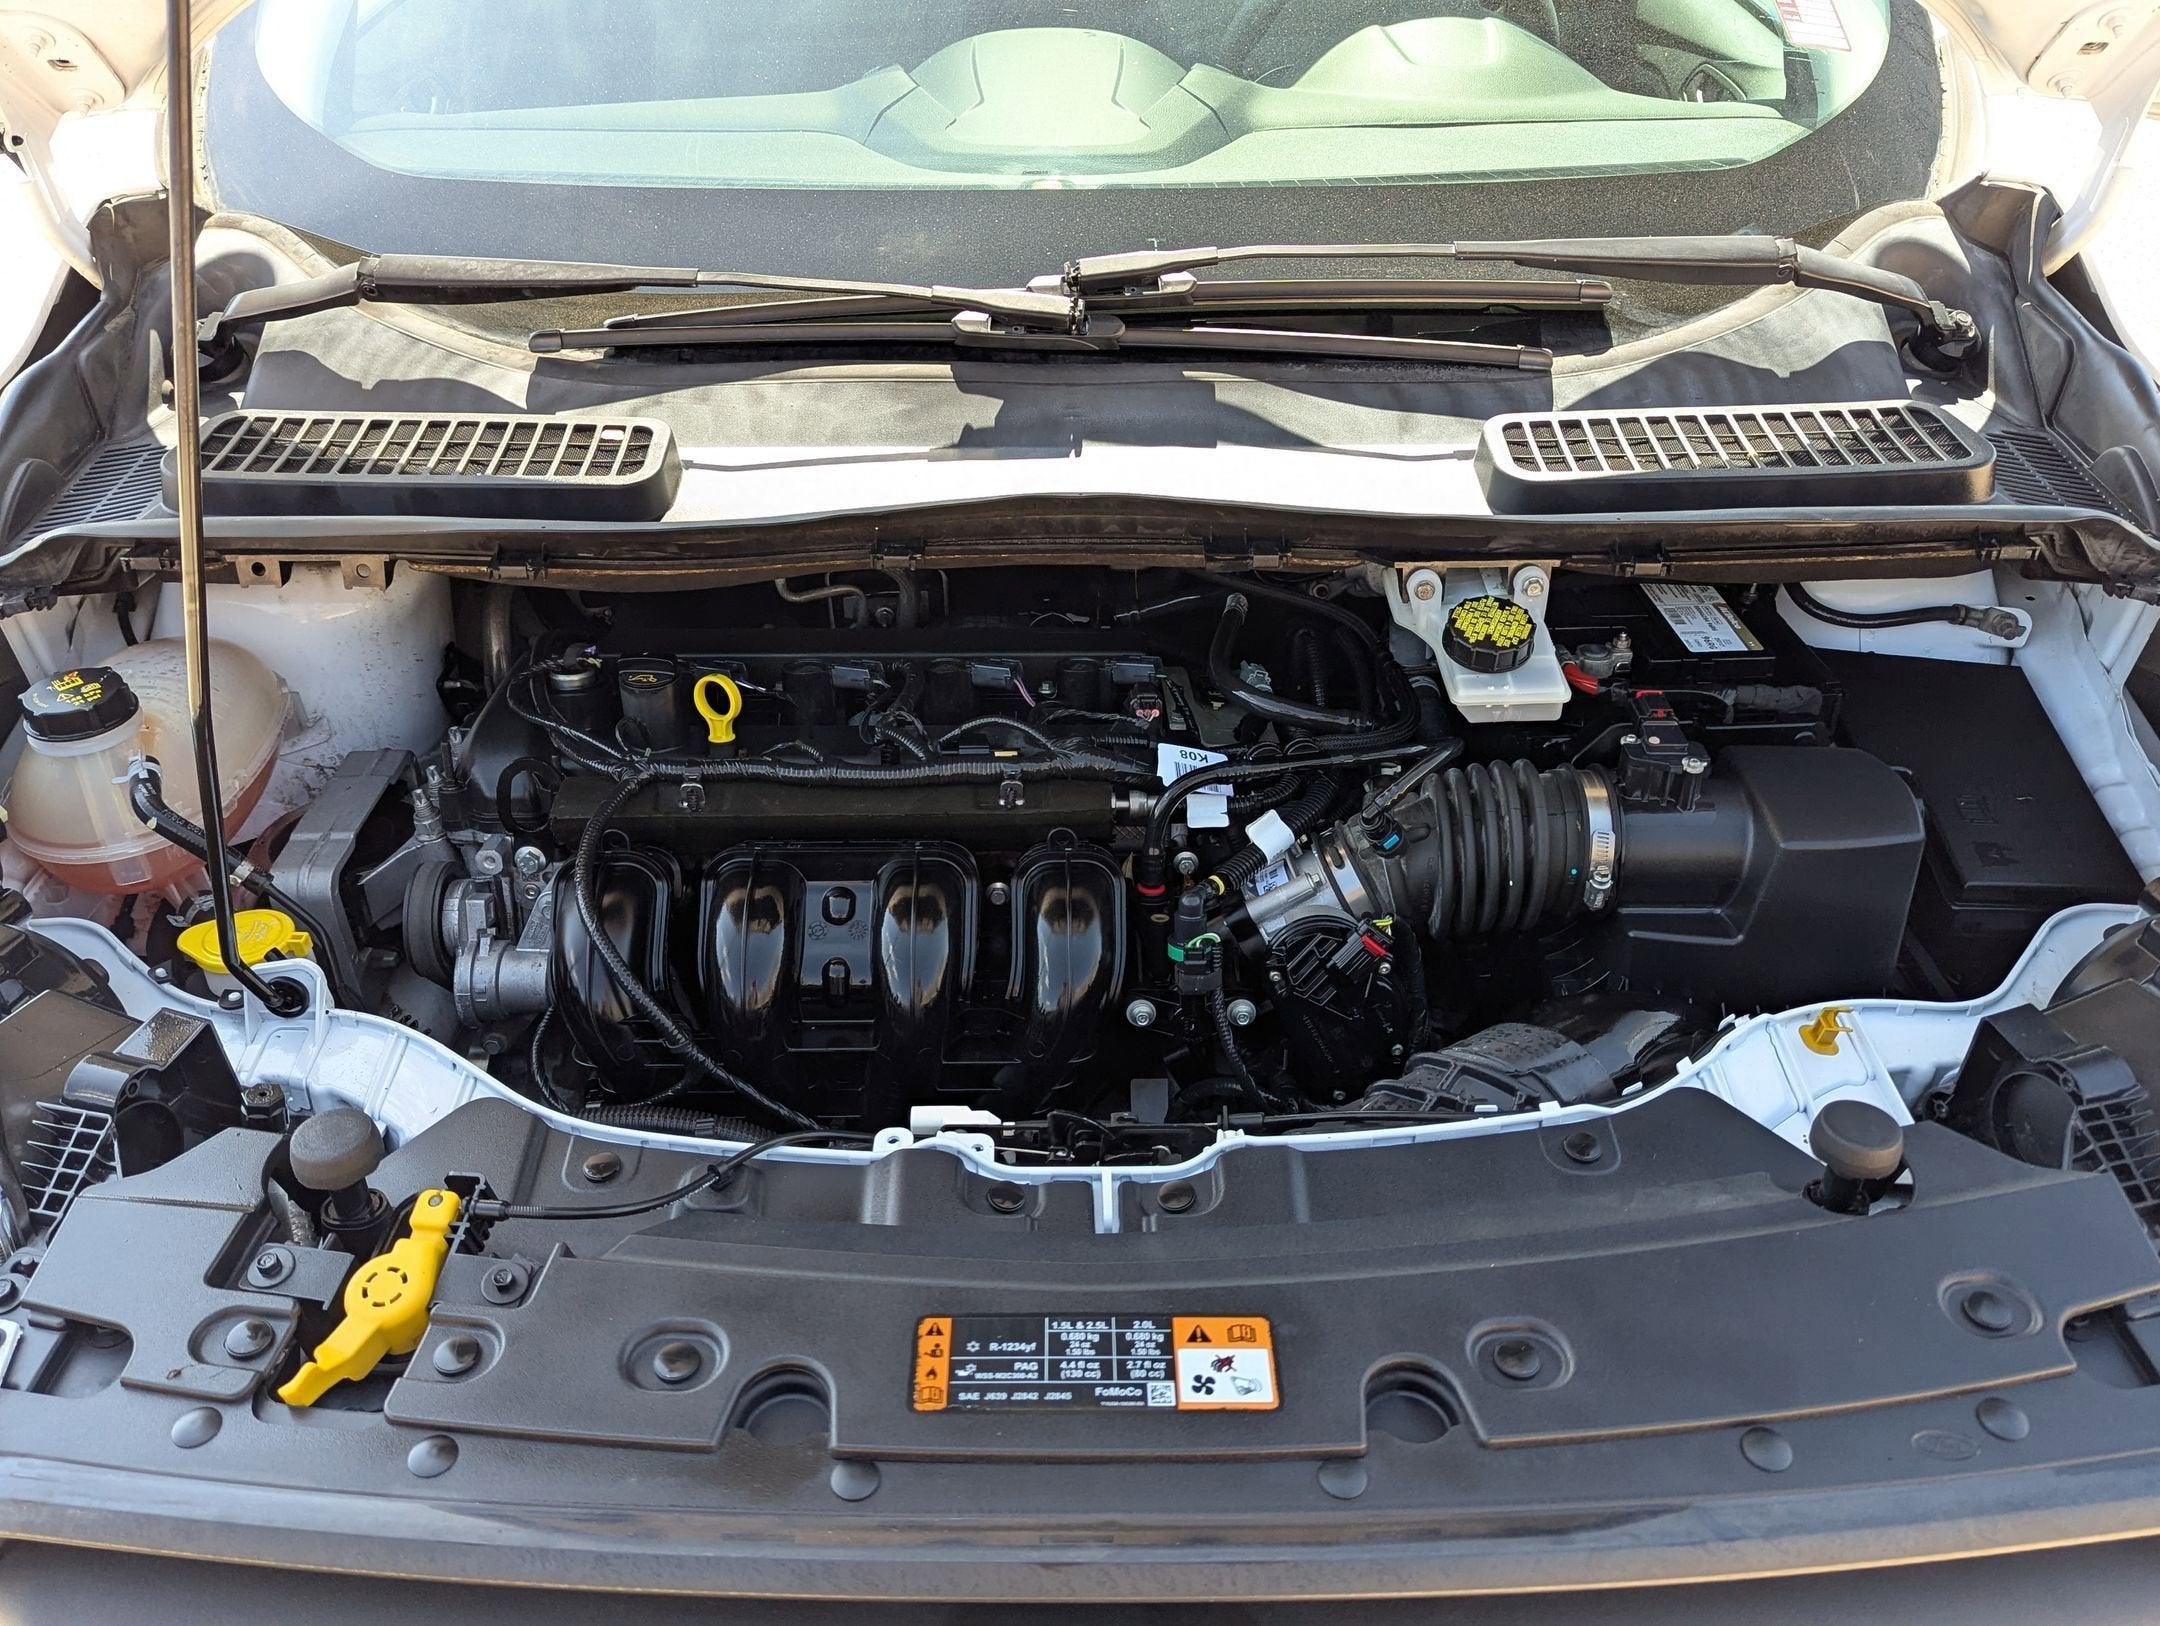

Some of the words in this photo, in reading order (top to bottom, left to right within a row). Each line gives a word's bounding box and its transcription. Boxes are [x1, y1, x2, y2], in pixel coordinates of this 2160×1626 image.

[1179, 749, 1209, 763] K08
[1051, 1321, 1074, 1330] 1.5L
[1075, 1321, 1085, 1330] &
[1086, 1320, 1109, 1330] 2.5L
[1132, 1320, 1156, 1329] 2.0L
[1087, 1332, 1100, 1342] kg
[1151, 1332, 1165, 1342] kg
[989, 1342, 1037, 1353] R-1234yf
[1083, 1348, 1096, 1356] lbs
[1148, 1348, 1161, 1356] lbs
[1013, 1362, 1039, 1371] PAG
[1059, 1360, 1076, 1369] 4.4
[1077, 1360, 1086, 1369] fl
[1125, 1360, 1142, 1369] 2.7
[1143, 1360, 1152, 1369] fl
[1060, 1370, 1084, 1379] (130
[1084, 1370, 1102, 1379] cc)
[1148, 1370, 1165, 1379] cc)
[958, 1392, 980, 1400] SAE
[1094, 1387, 1143, 1397] FoMoCo
